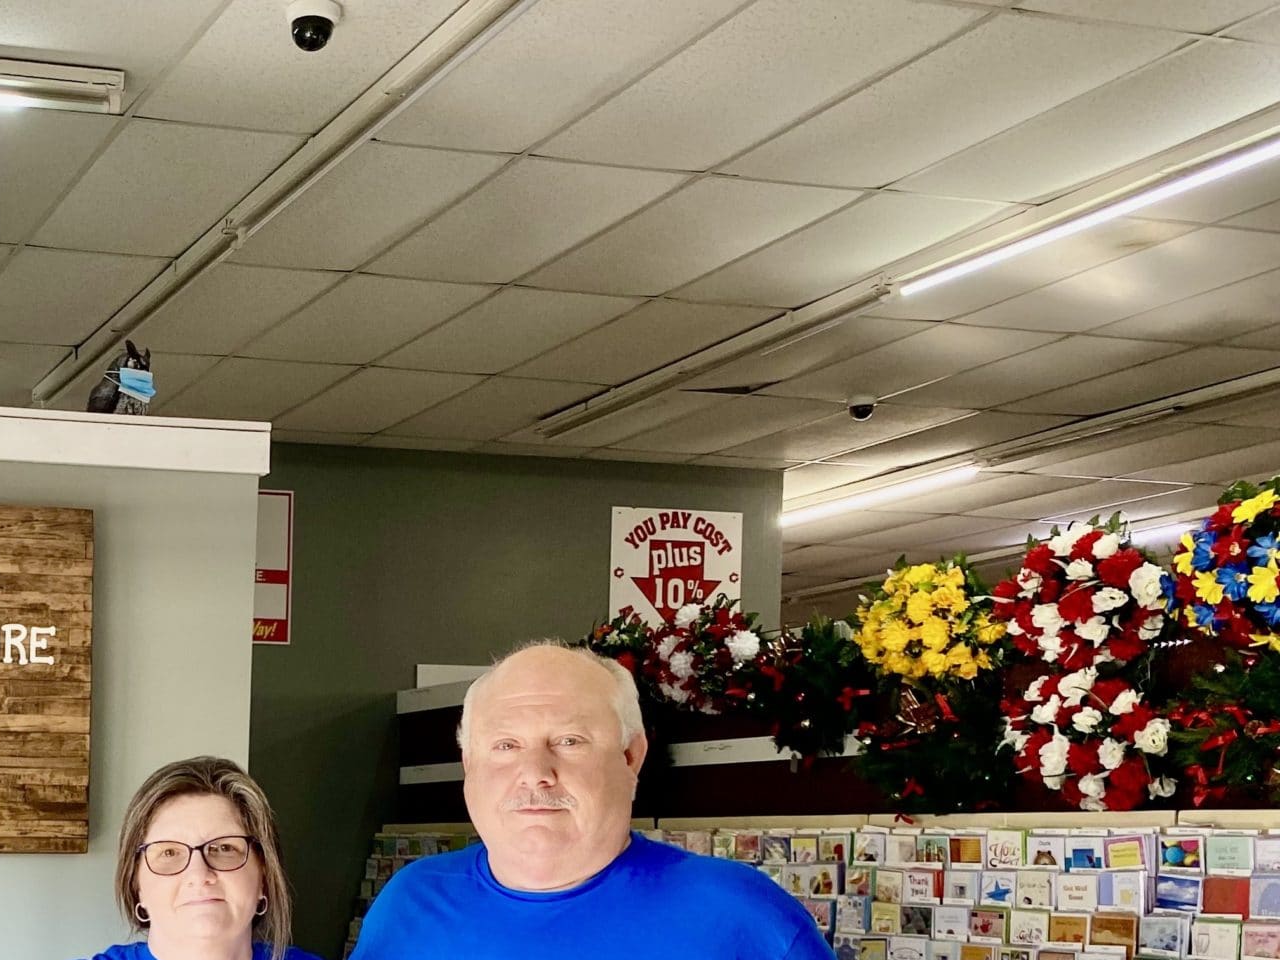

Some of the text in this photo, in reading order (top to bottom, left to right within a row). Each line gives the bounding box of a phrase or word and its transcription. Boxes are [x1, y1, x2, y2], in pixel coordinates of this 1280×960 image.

[624, 511, 733, 556] YOU PAY COST
[651, 543, 702, 576] plus
[654, 578, 704, 610] 10%
